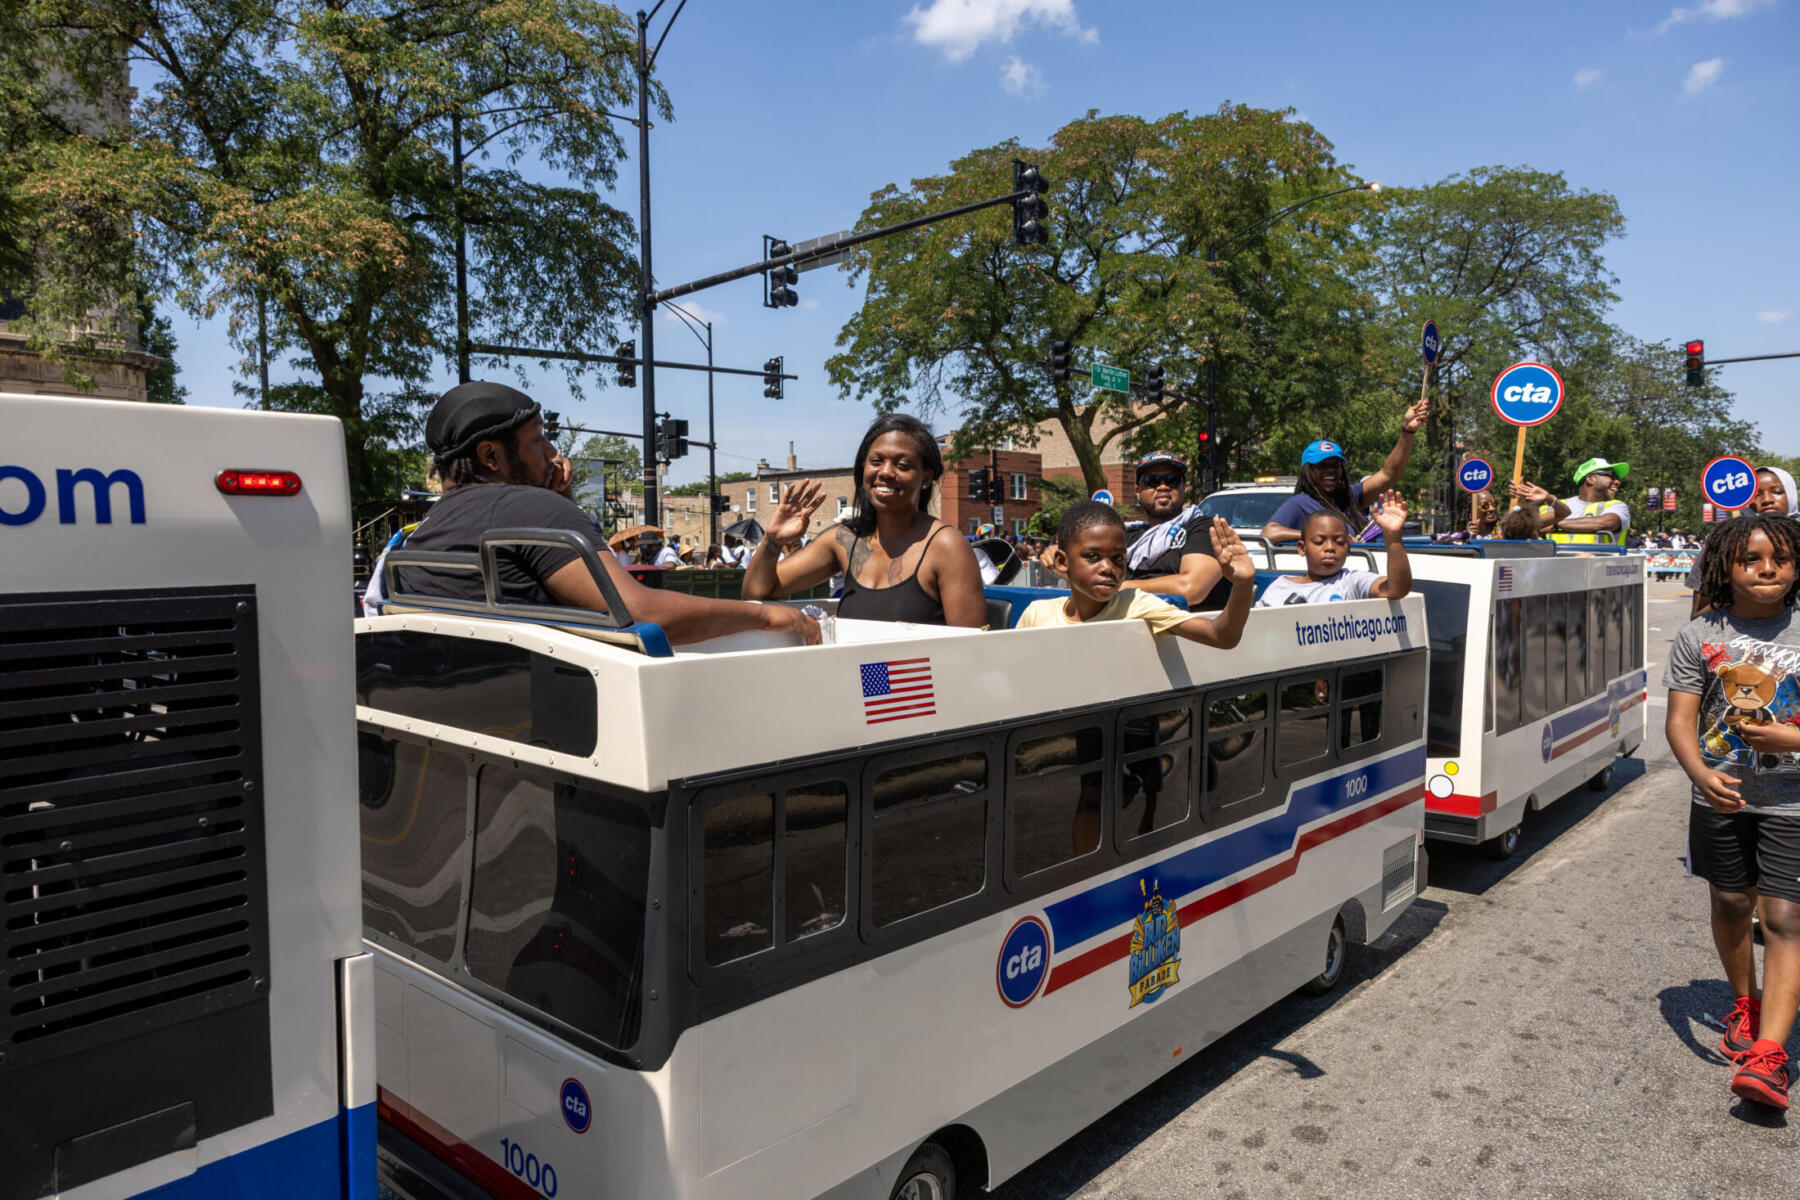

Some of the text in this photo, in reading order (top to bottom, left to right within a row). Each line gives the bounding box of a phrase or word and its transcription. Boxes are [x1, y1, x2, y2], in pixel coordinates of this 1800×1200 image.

[1504, 383, 1552, 403] cta
[1463, 469, 1488, 481] cta
[1712, 472, 1749, 494] cta
[1296, 615, 1407, 646] transitchicago.com
[1345, 774, 1368, 799] 1000
[1144, 913, 1167, 949] BUD
[1006, 945, 1042, 979] cta
[1139, 967, 1171, 992] PARADE
[565, 1096, 587, 1117] cta
[500, 1137, 558, 1199] 1000
